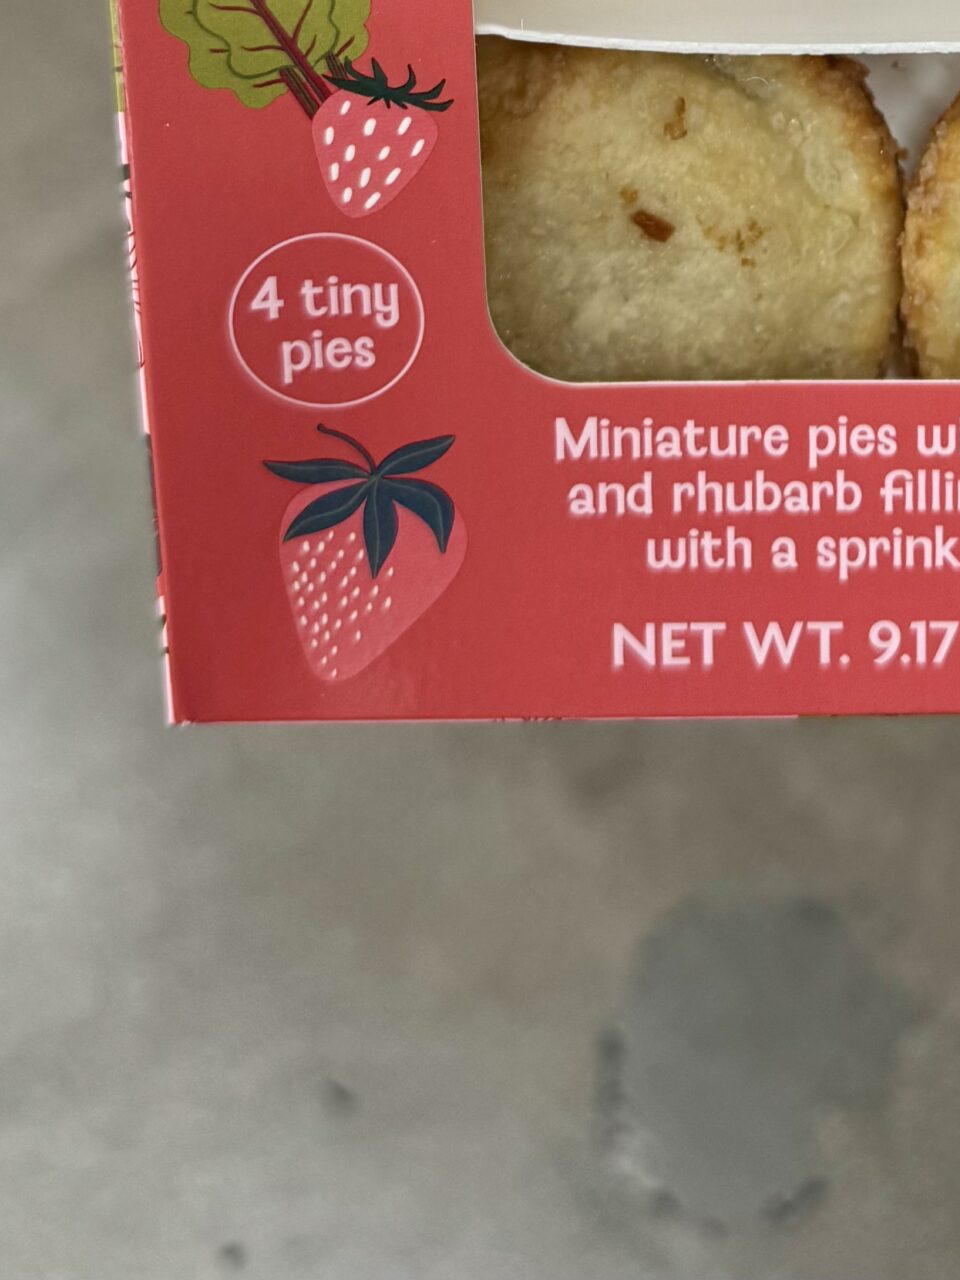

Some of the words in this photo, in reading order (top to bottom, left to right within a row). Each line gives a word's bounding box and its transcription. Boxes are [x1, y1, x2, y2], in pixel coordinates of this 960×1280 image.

[251, 276, 285, 320] 4
[301, 275, 400, 328] tiny
[282, 330, 376, 385] pies
[555, 416, 789, 461] Miniature
[808, 416, 898, 467] pies
[568, 471, 653, 516] and
[673, 470, 863, 514] rhubarb
[646, 527, 752, 570] with
[771, 537, 798, 570] a
[612, 622, 727, 668] NET
[743, 621, 851, 667] WT.
[868, 621, 960, 667] 9.17
